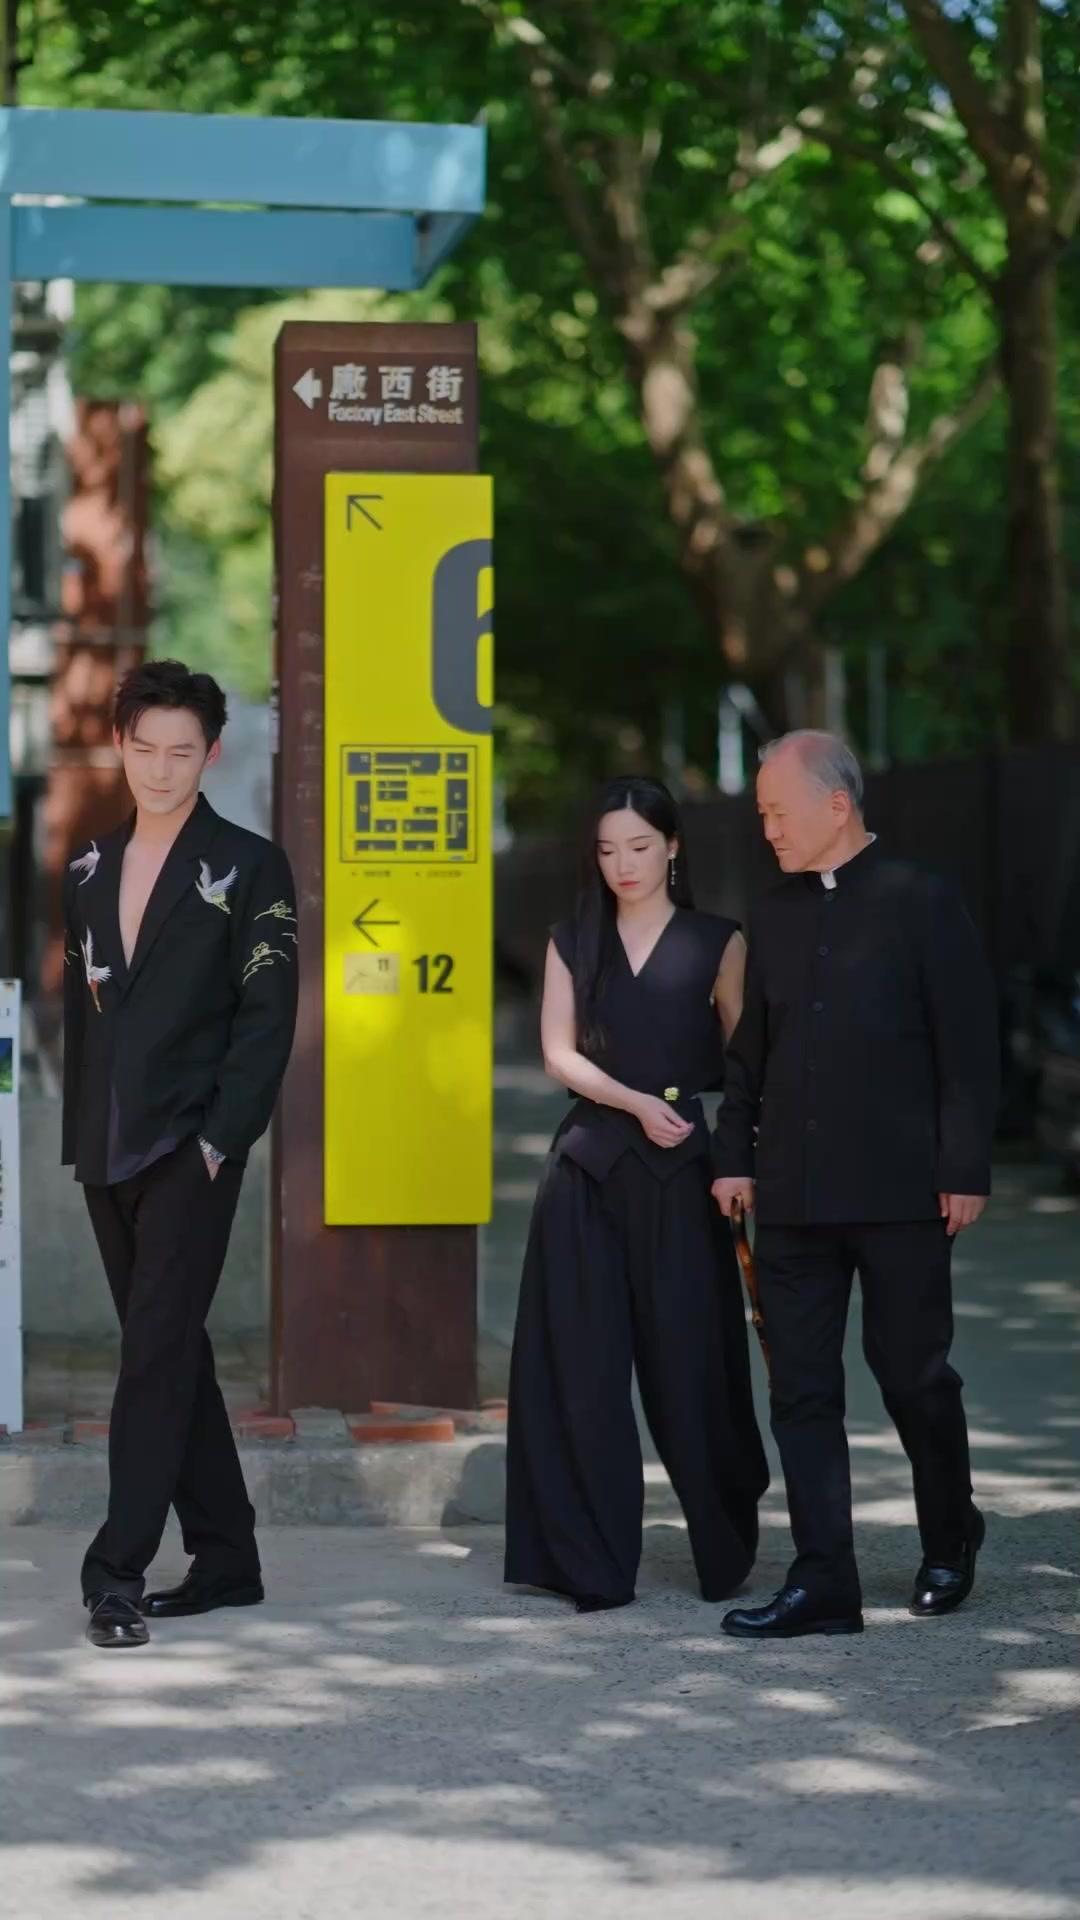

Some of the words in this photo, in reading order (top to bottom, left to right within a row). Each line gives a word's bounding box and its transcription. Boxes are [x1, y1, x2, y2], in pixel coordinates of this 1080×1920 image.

[329, 363, 463, 401] 廠西街
[328, 402, 383, 425] Factory
[384, 403, 416, 423] East
[418, 403, 463, 424] Street
[412, 954, 454, 993] 12
